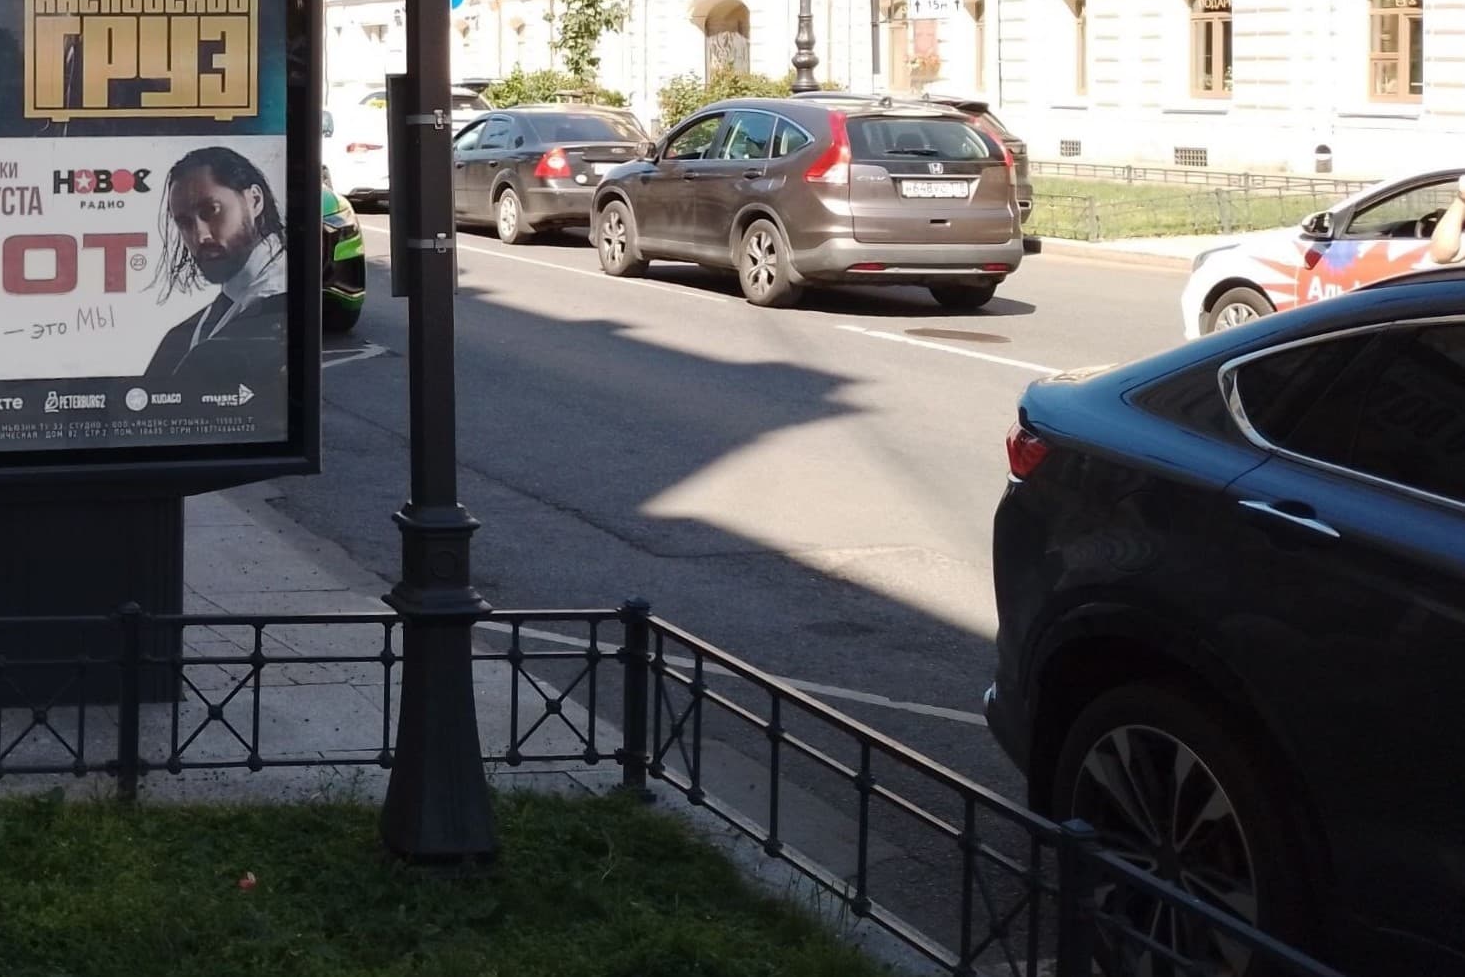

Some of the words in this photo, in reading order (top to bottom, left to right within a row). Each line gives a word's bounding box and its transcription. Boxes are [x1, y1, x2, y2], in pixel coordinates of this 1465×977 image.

[35, 16, 249, 109] ГРУЗ
[79, 199, 125, 210] РАДИО
[32, 322, 67, 340] это
